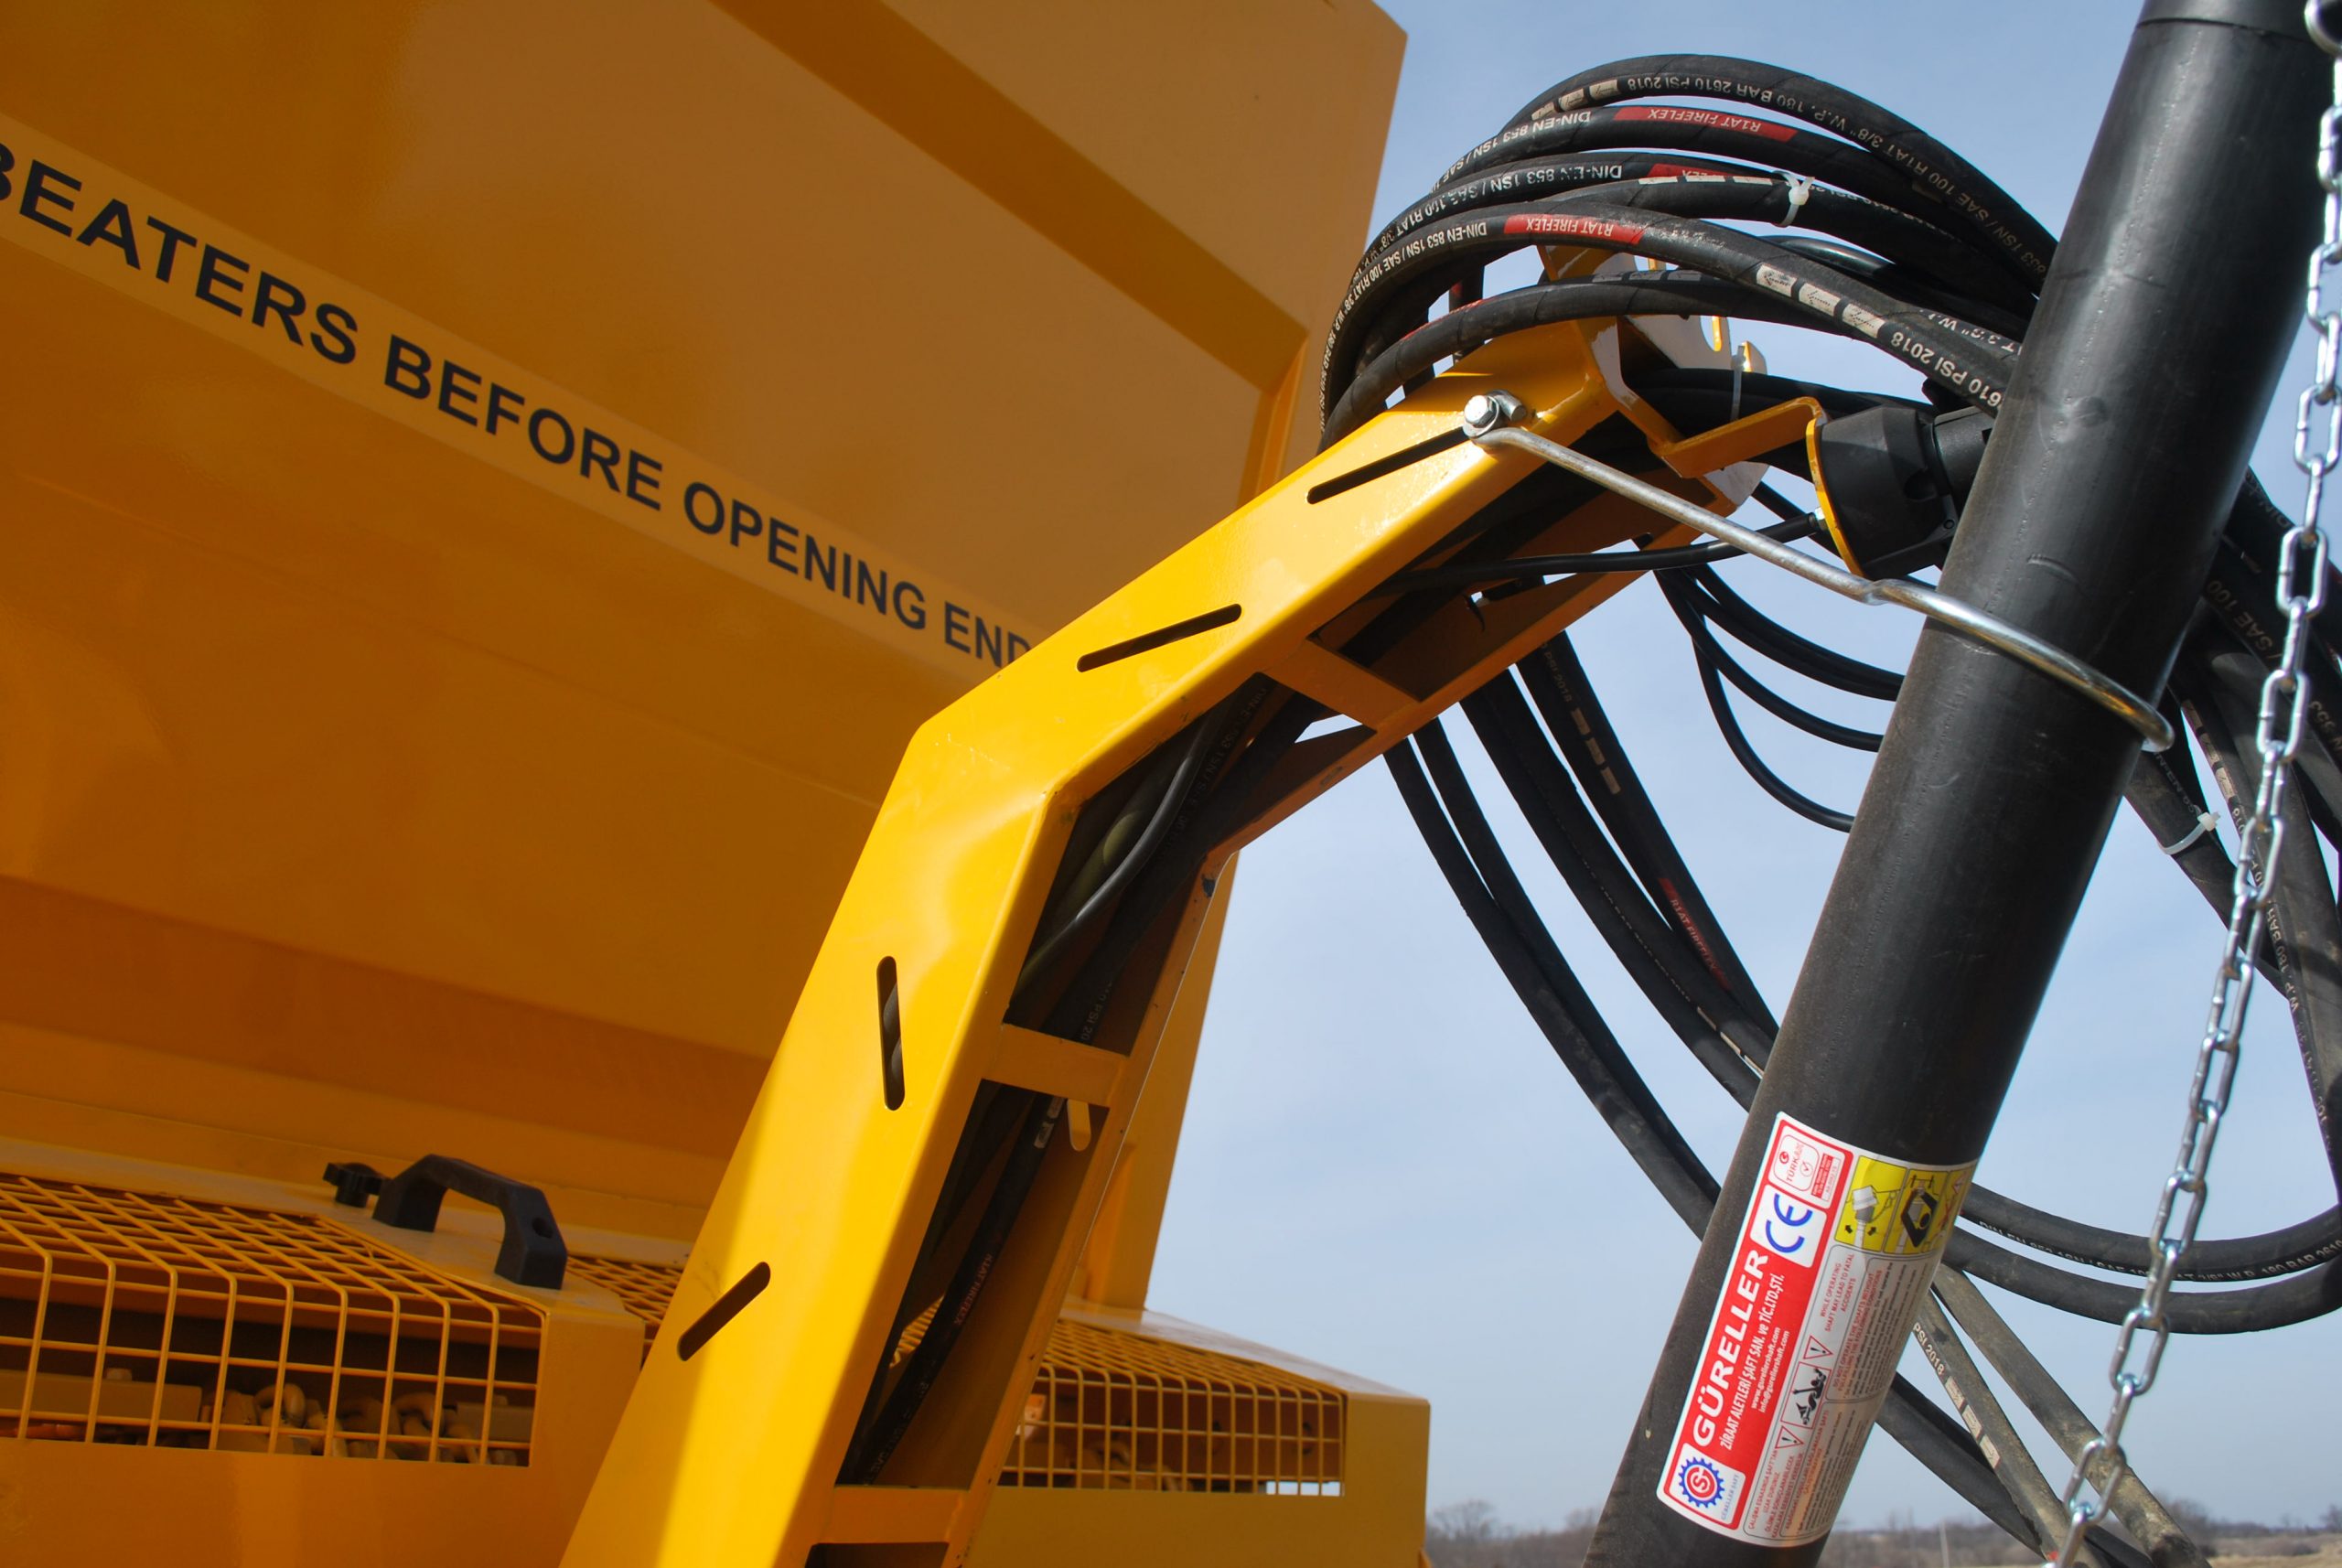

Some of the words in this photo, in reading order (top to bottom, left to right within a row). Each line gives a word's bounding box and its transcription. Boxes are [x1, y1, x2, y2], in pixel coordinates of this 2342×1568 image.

[1627, 75, 1661, 90] 2018
[1663, 75, 1689, 89] PSI
[1694, 77, 1731, 92] 2610
[1735, 81, 1773, 102] BAR
[1775, 93, 1803, 113] 180
[1531, 109, 1590, 132] DIN-EN
[1647, 107, 1717, 124] FIREFLEX
[1721, 115, 1761, 133] R1AT
[1502, 124, 1528, 141] 853
[1849, 127, 1884, 148] 3/8"
[1474, 136, 1497, 158] 1SN
[1882, 143, 1928, 175] R1AT
[1488, 173, 1520, 194] 1SN
[1525, 166, 1554, 185] 853
[1927, 169, 1956, 195] 100
[1955, 191, 1990, 221] SAE
[1393, 207, 1423, 234] R1AT
[1445, 220, 1487, 242] DIN-EN
[1524, 218, 1578, 233] FIREFLEX
[1581, 220, 1613, 235] R1AT
[1404, 238, 1425, 257] 1SN
[1425, 230, 1445, 248] 853
[1381, 249, 1402, 272] SAE
[1368, 263, 1381, 282] 100
[1350, 274, 1371, 301] R1AT
[1888, 329, 1935, 365] 2018
[1933, 355, 1968, 386] PSI
[1966, 376, 2004, 410] 610
[382, 333, 664, 511] BEFORE
[682, 480, 928, 631] OPENING
[2206, 577, 2239, 613] 100
[1756, 1272, 1785, 1324] TİC.LTD.ŞTİ.
[1758, 1323, 1769, 1335] ve
[1693, 1248, 1770, 1447] GÜRELLER
[1749, 1336, 1766, 1358] SAN.
[1912, 1321, 1928, 1347] PSI
[1924, 1342, 1945, 1376] 2018
[1741, 1354, 1758, 1380] ŞAFT
[1749, 1326, 1781, 1409] www.gurellershaft.com
[1757, 1329, 1790, 1412] info@gurellershaft.com
[1729, 1376, 1751, 1419] ALETLERİ
[1719, 1415, 1739, 1450] ZİRAAT
